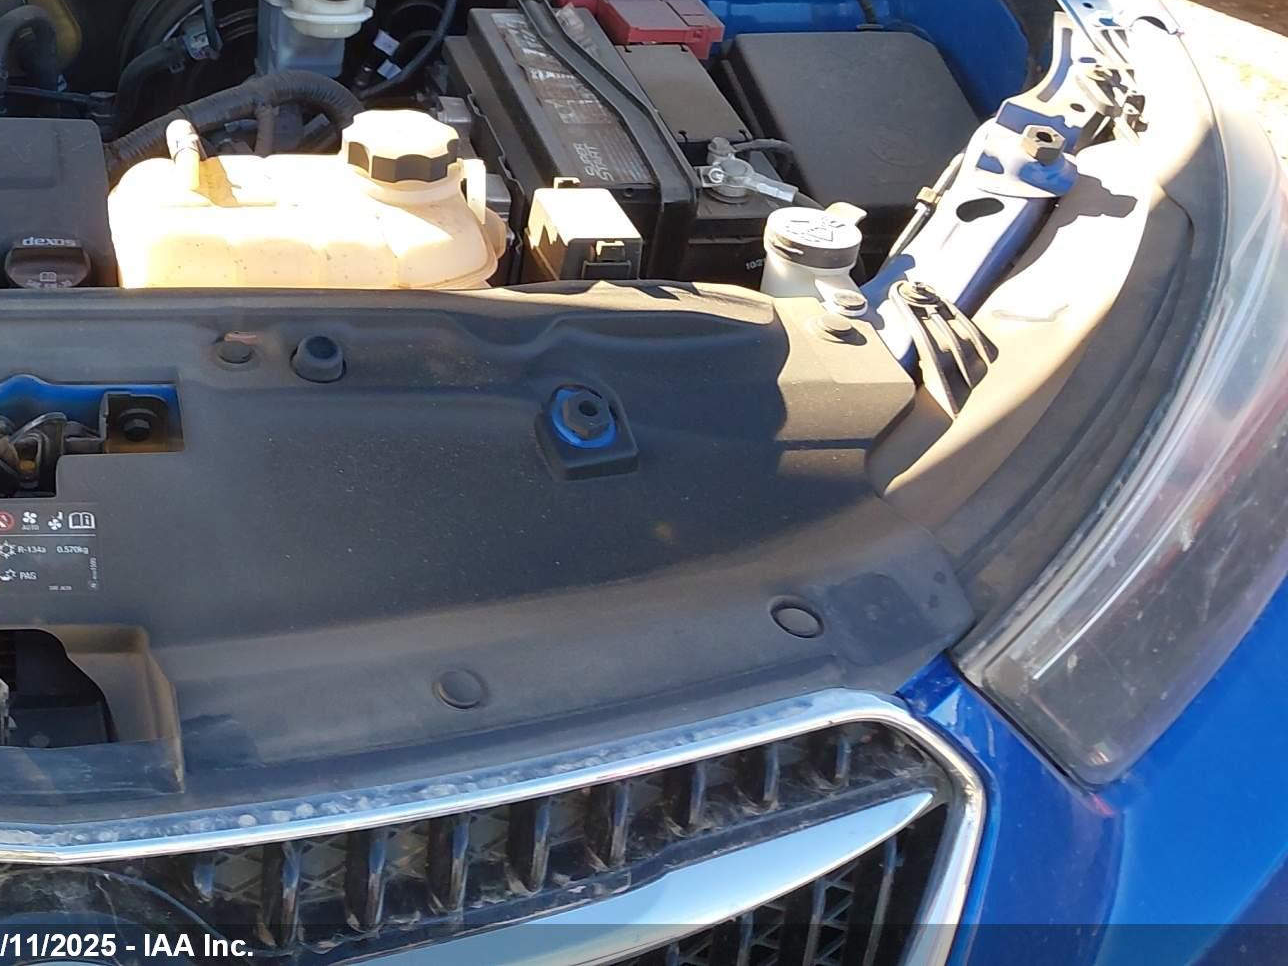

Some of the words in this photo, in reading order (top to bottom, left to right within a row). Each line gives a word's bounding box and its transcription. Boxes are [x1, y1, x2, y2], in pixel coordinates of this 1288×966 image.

[584, 143, 612, 181] START
[22, 237, 77, 246] dexos
[18, 545, 46, 553] R-134a
[20, 572, 37, 580] PAG
